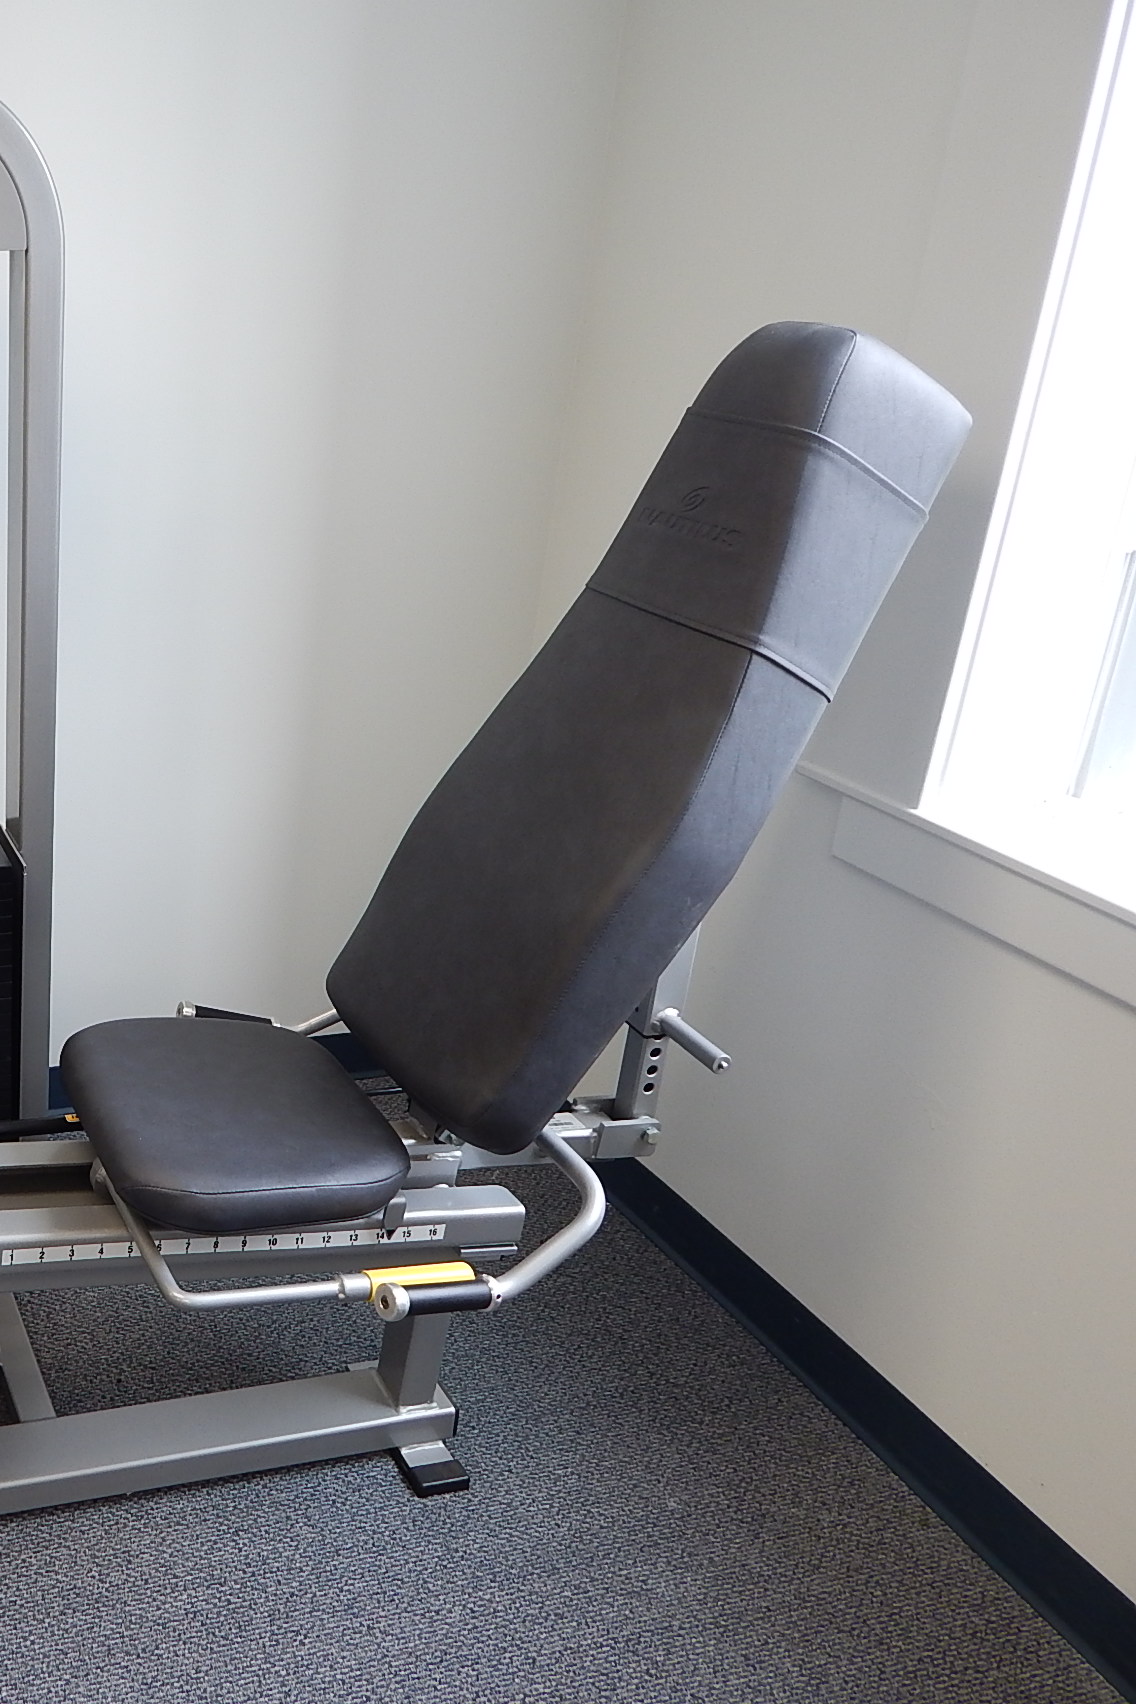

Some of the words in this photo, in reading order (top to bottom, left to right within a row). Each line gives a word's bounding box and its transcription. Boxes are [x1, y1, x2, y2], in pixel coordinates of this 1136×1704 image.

[39, 1251, 45, 1260] 2
[68, 1249, 75, 1257] 3
[98, 1247, 104, 1255] 4
[127, 1245, 134, 1253] 5
[156, 1243, 162, 1252] 6
[185, 1242, 191, 1250] 7
[213, 1241, 219, 1249] 8
[241, 1239, 247, 1248] 9
[267, 1238, 277, 1246] 10
[295, 1237, 304, 1245] 11
[321, 1235, 331, 1243] 12
[349, 1234, 359, 1242] 13
[375, 1231, 384, 1240] 14
[402, 1230, 411, 1238] 15
[428, 1228, 437, 1236] 16
